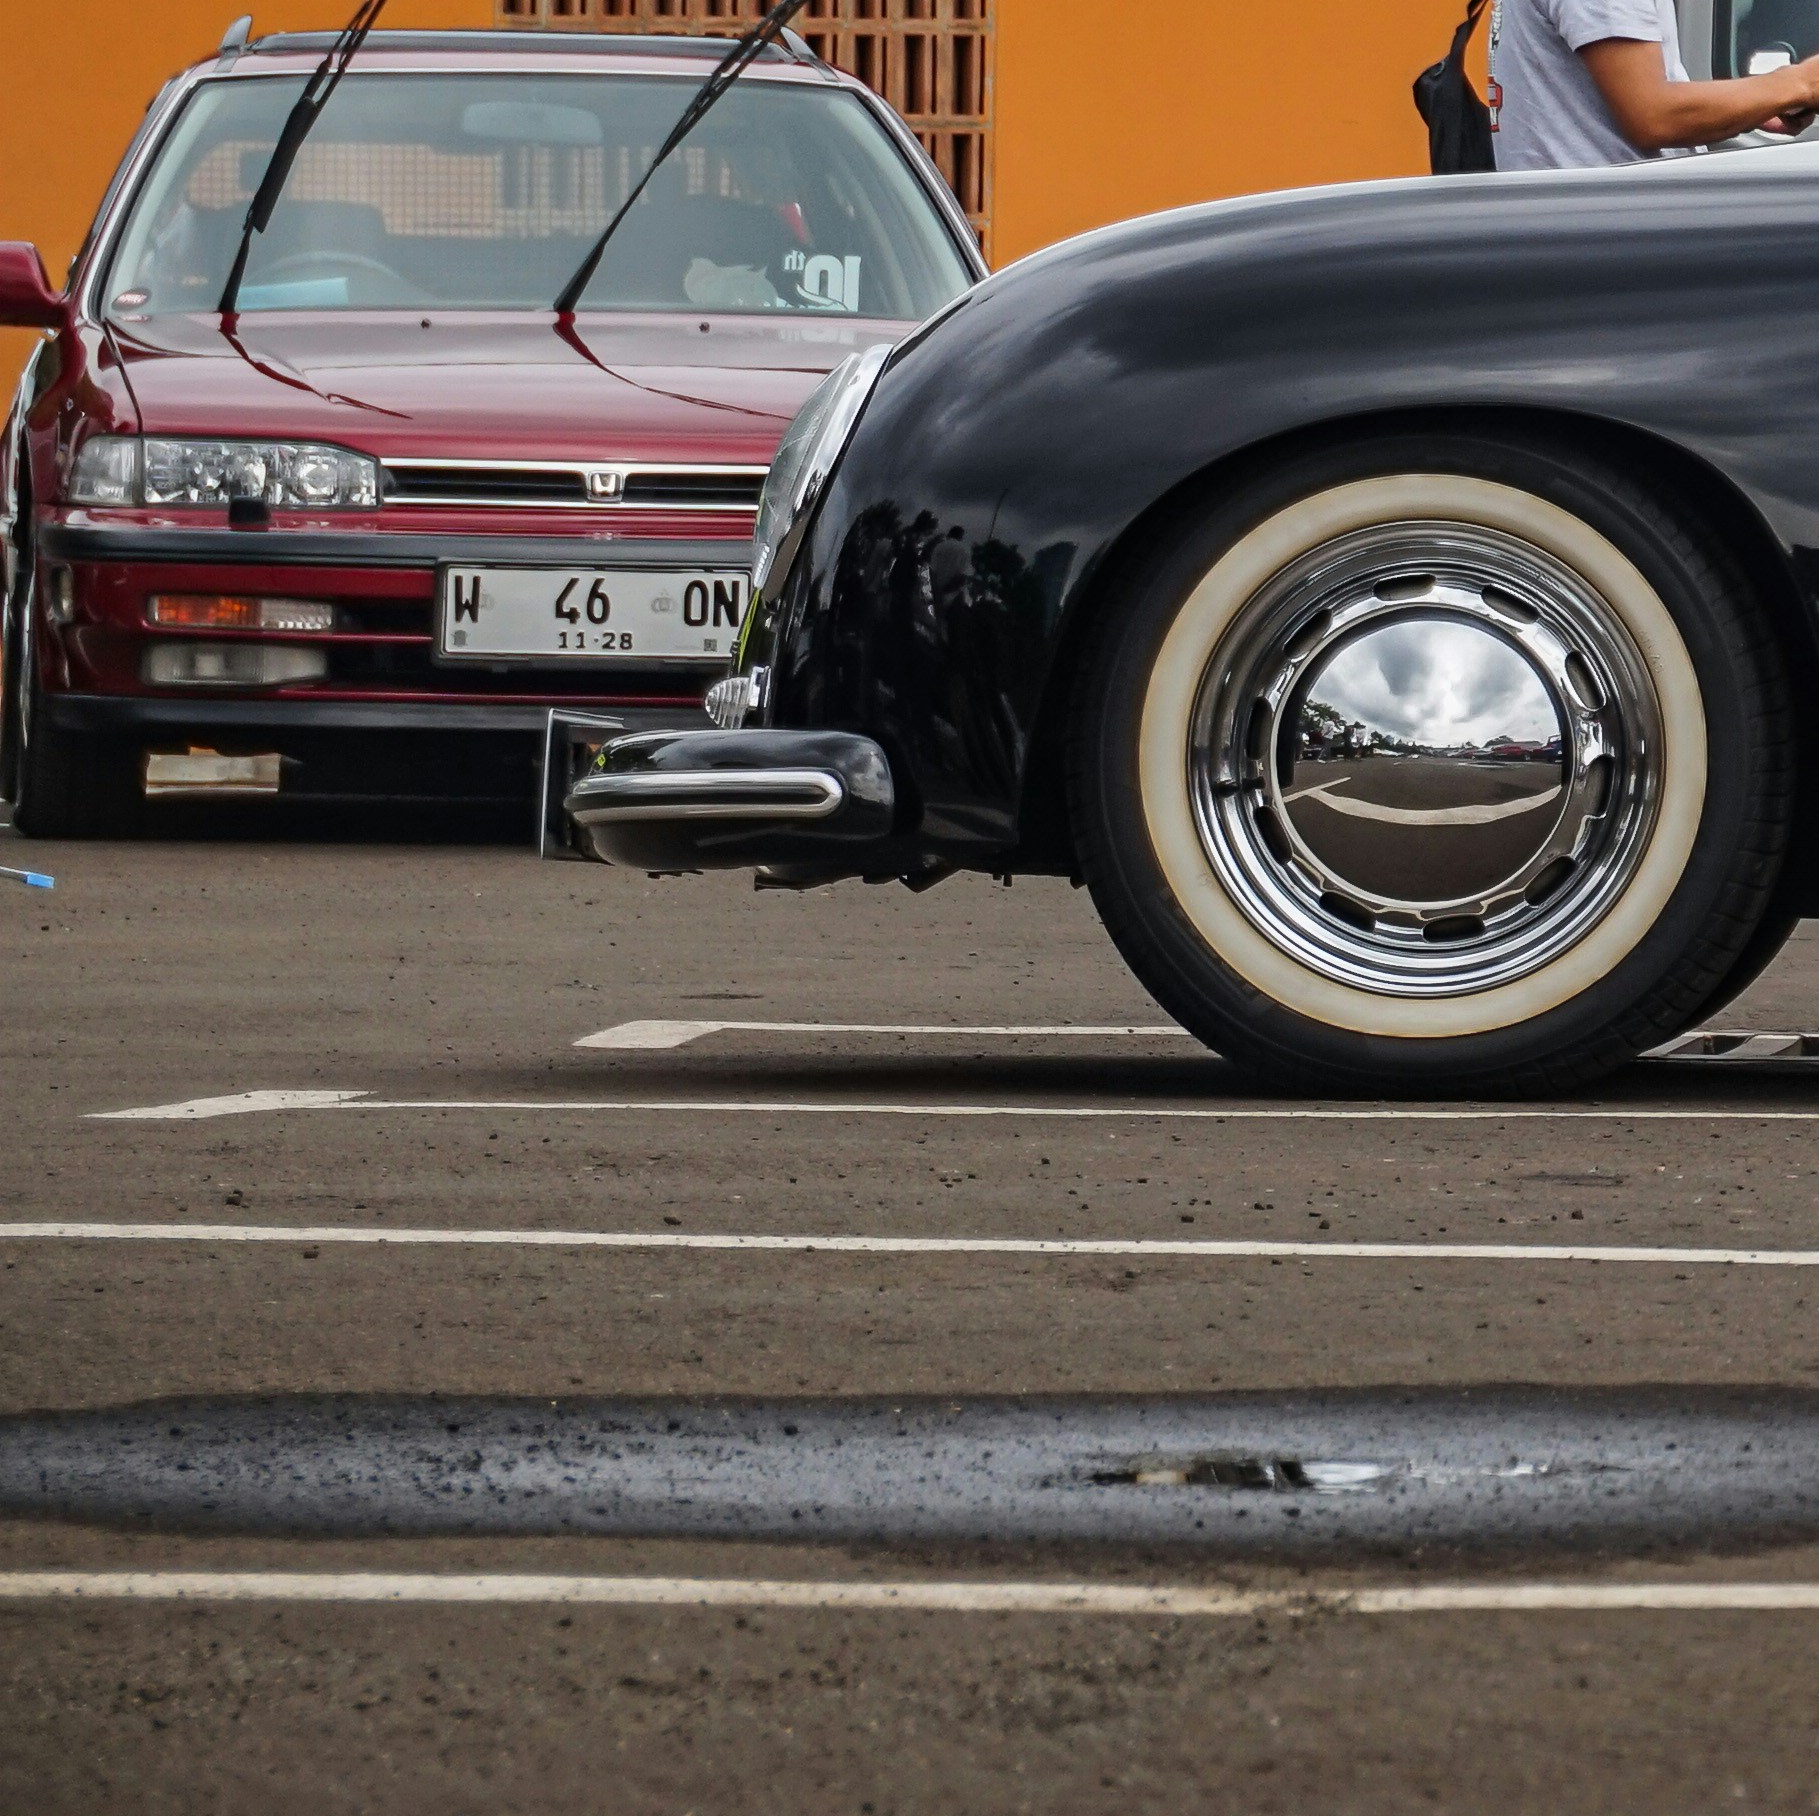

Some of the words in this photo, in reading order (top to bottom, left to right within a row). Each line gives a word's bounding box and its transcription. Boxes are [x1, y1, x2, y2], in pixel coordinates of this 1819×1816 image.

[454, 575, 481, 624] W
[555, 577, 611, 625] 46
[683, 579, 741, 627] ON
